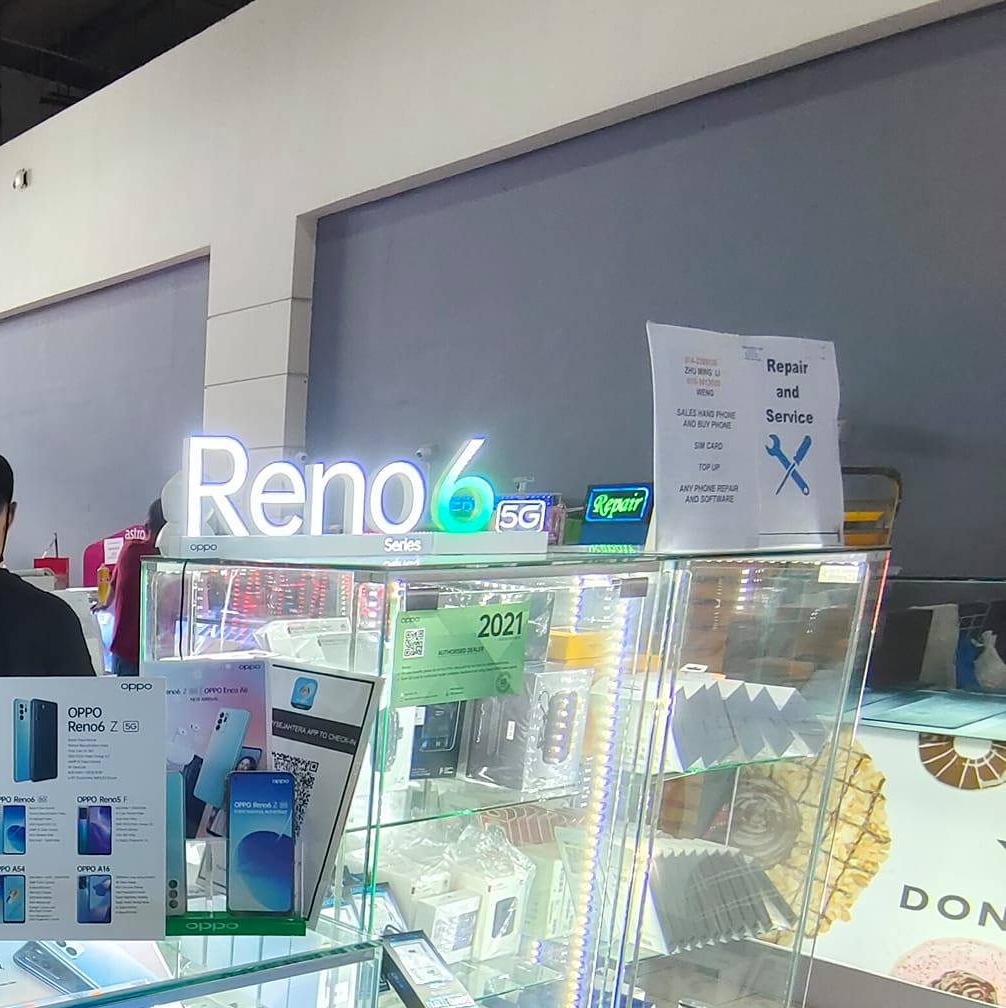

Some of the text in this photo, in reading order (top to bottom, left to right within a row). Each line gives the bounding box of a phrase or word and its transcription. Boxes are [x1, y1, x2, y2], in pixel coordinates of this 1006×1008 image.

[767, 358, 809, 376] Repair
[776, 386, 800, 399] and
[676, 408, 696, 417] SALES
[716, 410, 736, 420] PHONE
[766, 408, 814, 424] Service
[682, 420, 696, 428] AND
[711, 421, 732, 430] PHONE
[694, 441, 705, 450] SIM
[698, 463, 708, 472] TOP
[187, 434, 543, 537] Reno6 5G
[679, 484, 739, 493] ANY PHONE REPAIR
[593, 492, 644, 519] Repair
[685, 495, 735, 504] AND SOFTWARE
[124, 527, 146, 540] astro
[189, 537, 422, 552] oppo Series
[478, 611, 524, 639] 2021
[120, 682, 153, 692] oppo
[67, 706, 103, 719] OPPO
[68, 720, 138, 732] Reno6 Z 5G
[12, 865, 25, 873] A54
[76, 865, 111, 873] OPPO A16
[185, 922, 239, 931] oppo
